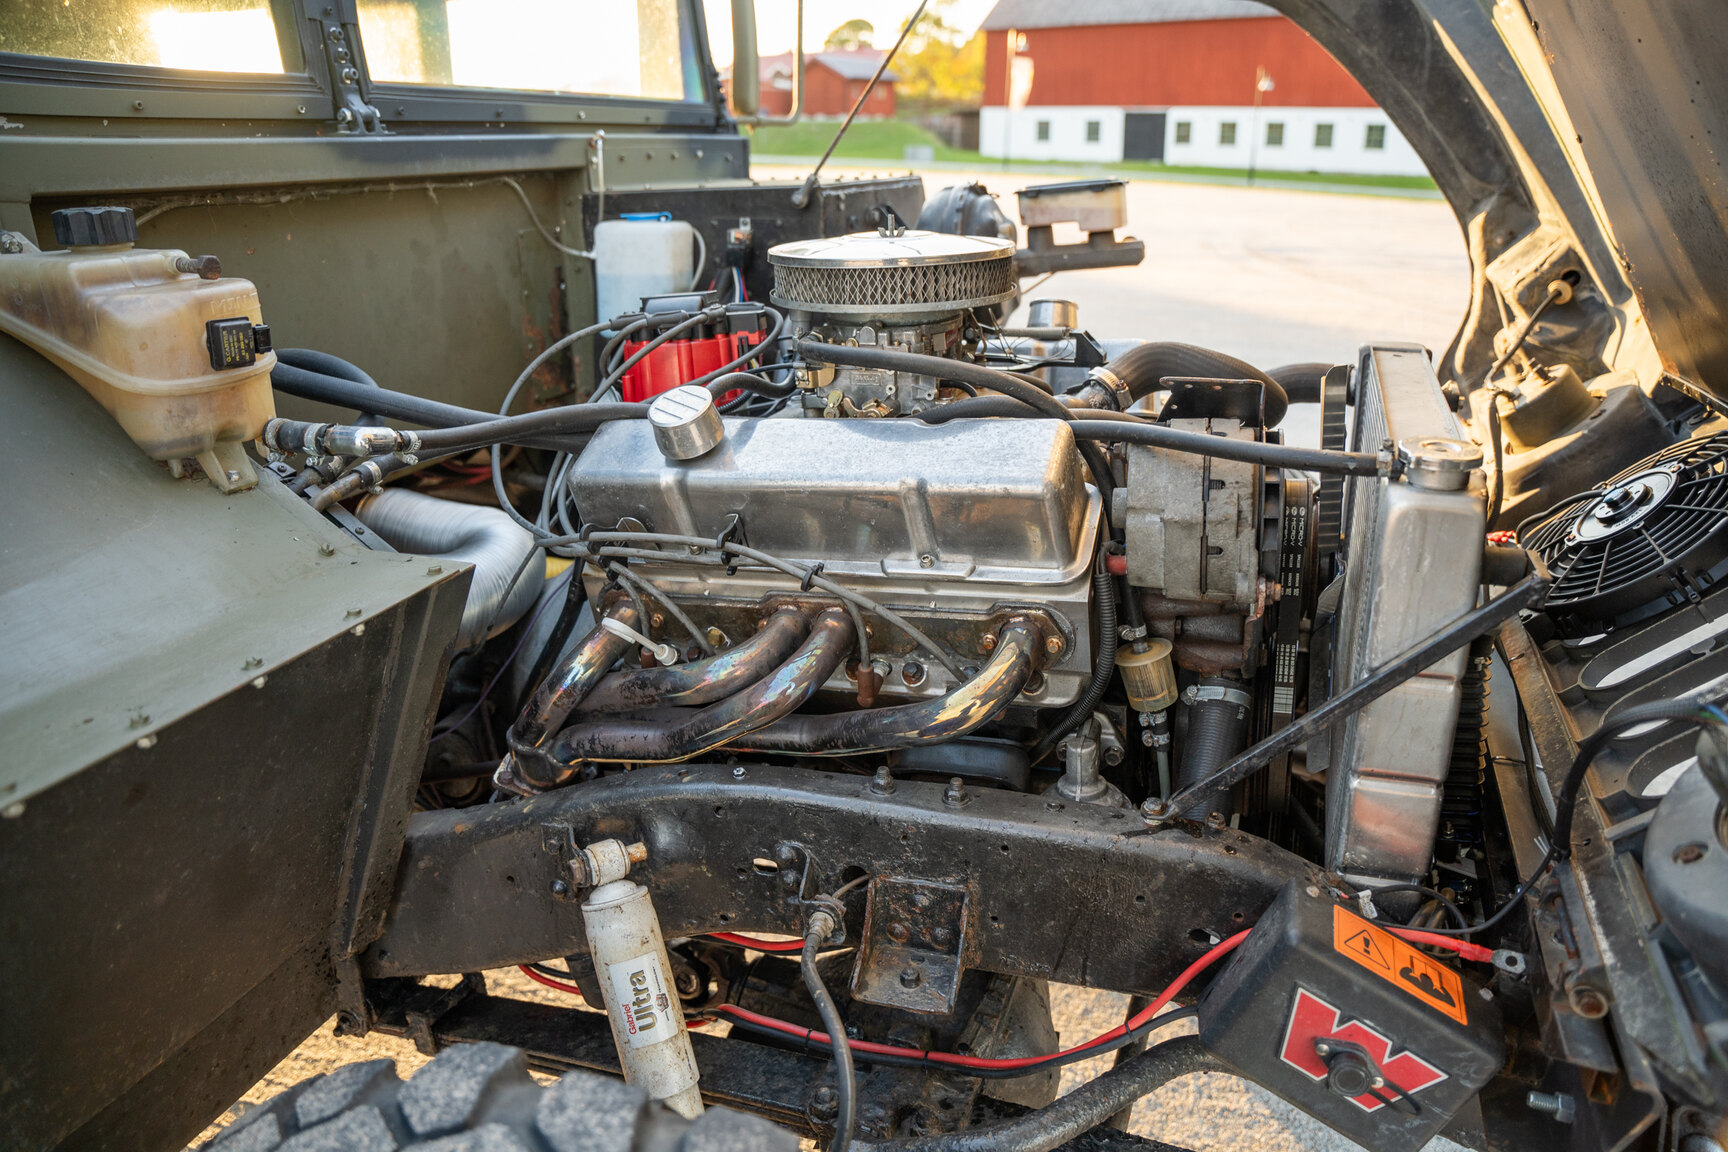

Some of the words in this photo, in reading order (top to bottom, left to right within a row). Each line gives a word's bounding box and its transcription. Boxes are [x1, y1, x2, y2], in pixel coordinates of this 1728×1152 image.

[1297, 517, 1305, 547] MICRO-V
[630, 969, 657, 1032] Ultra
[622, 1003, 637, 1034] Gabriel
